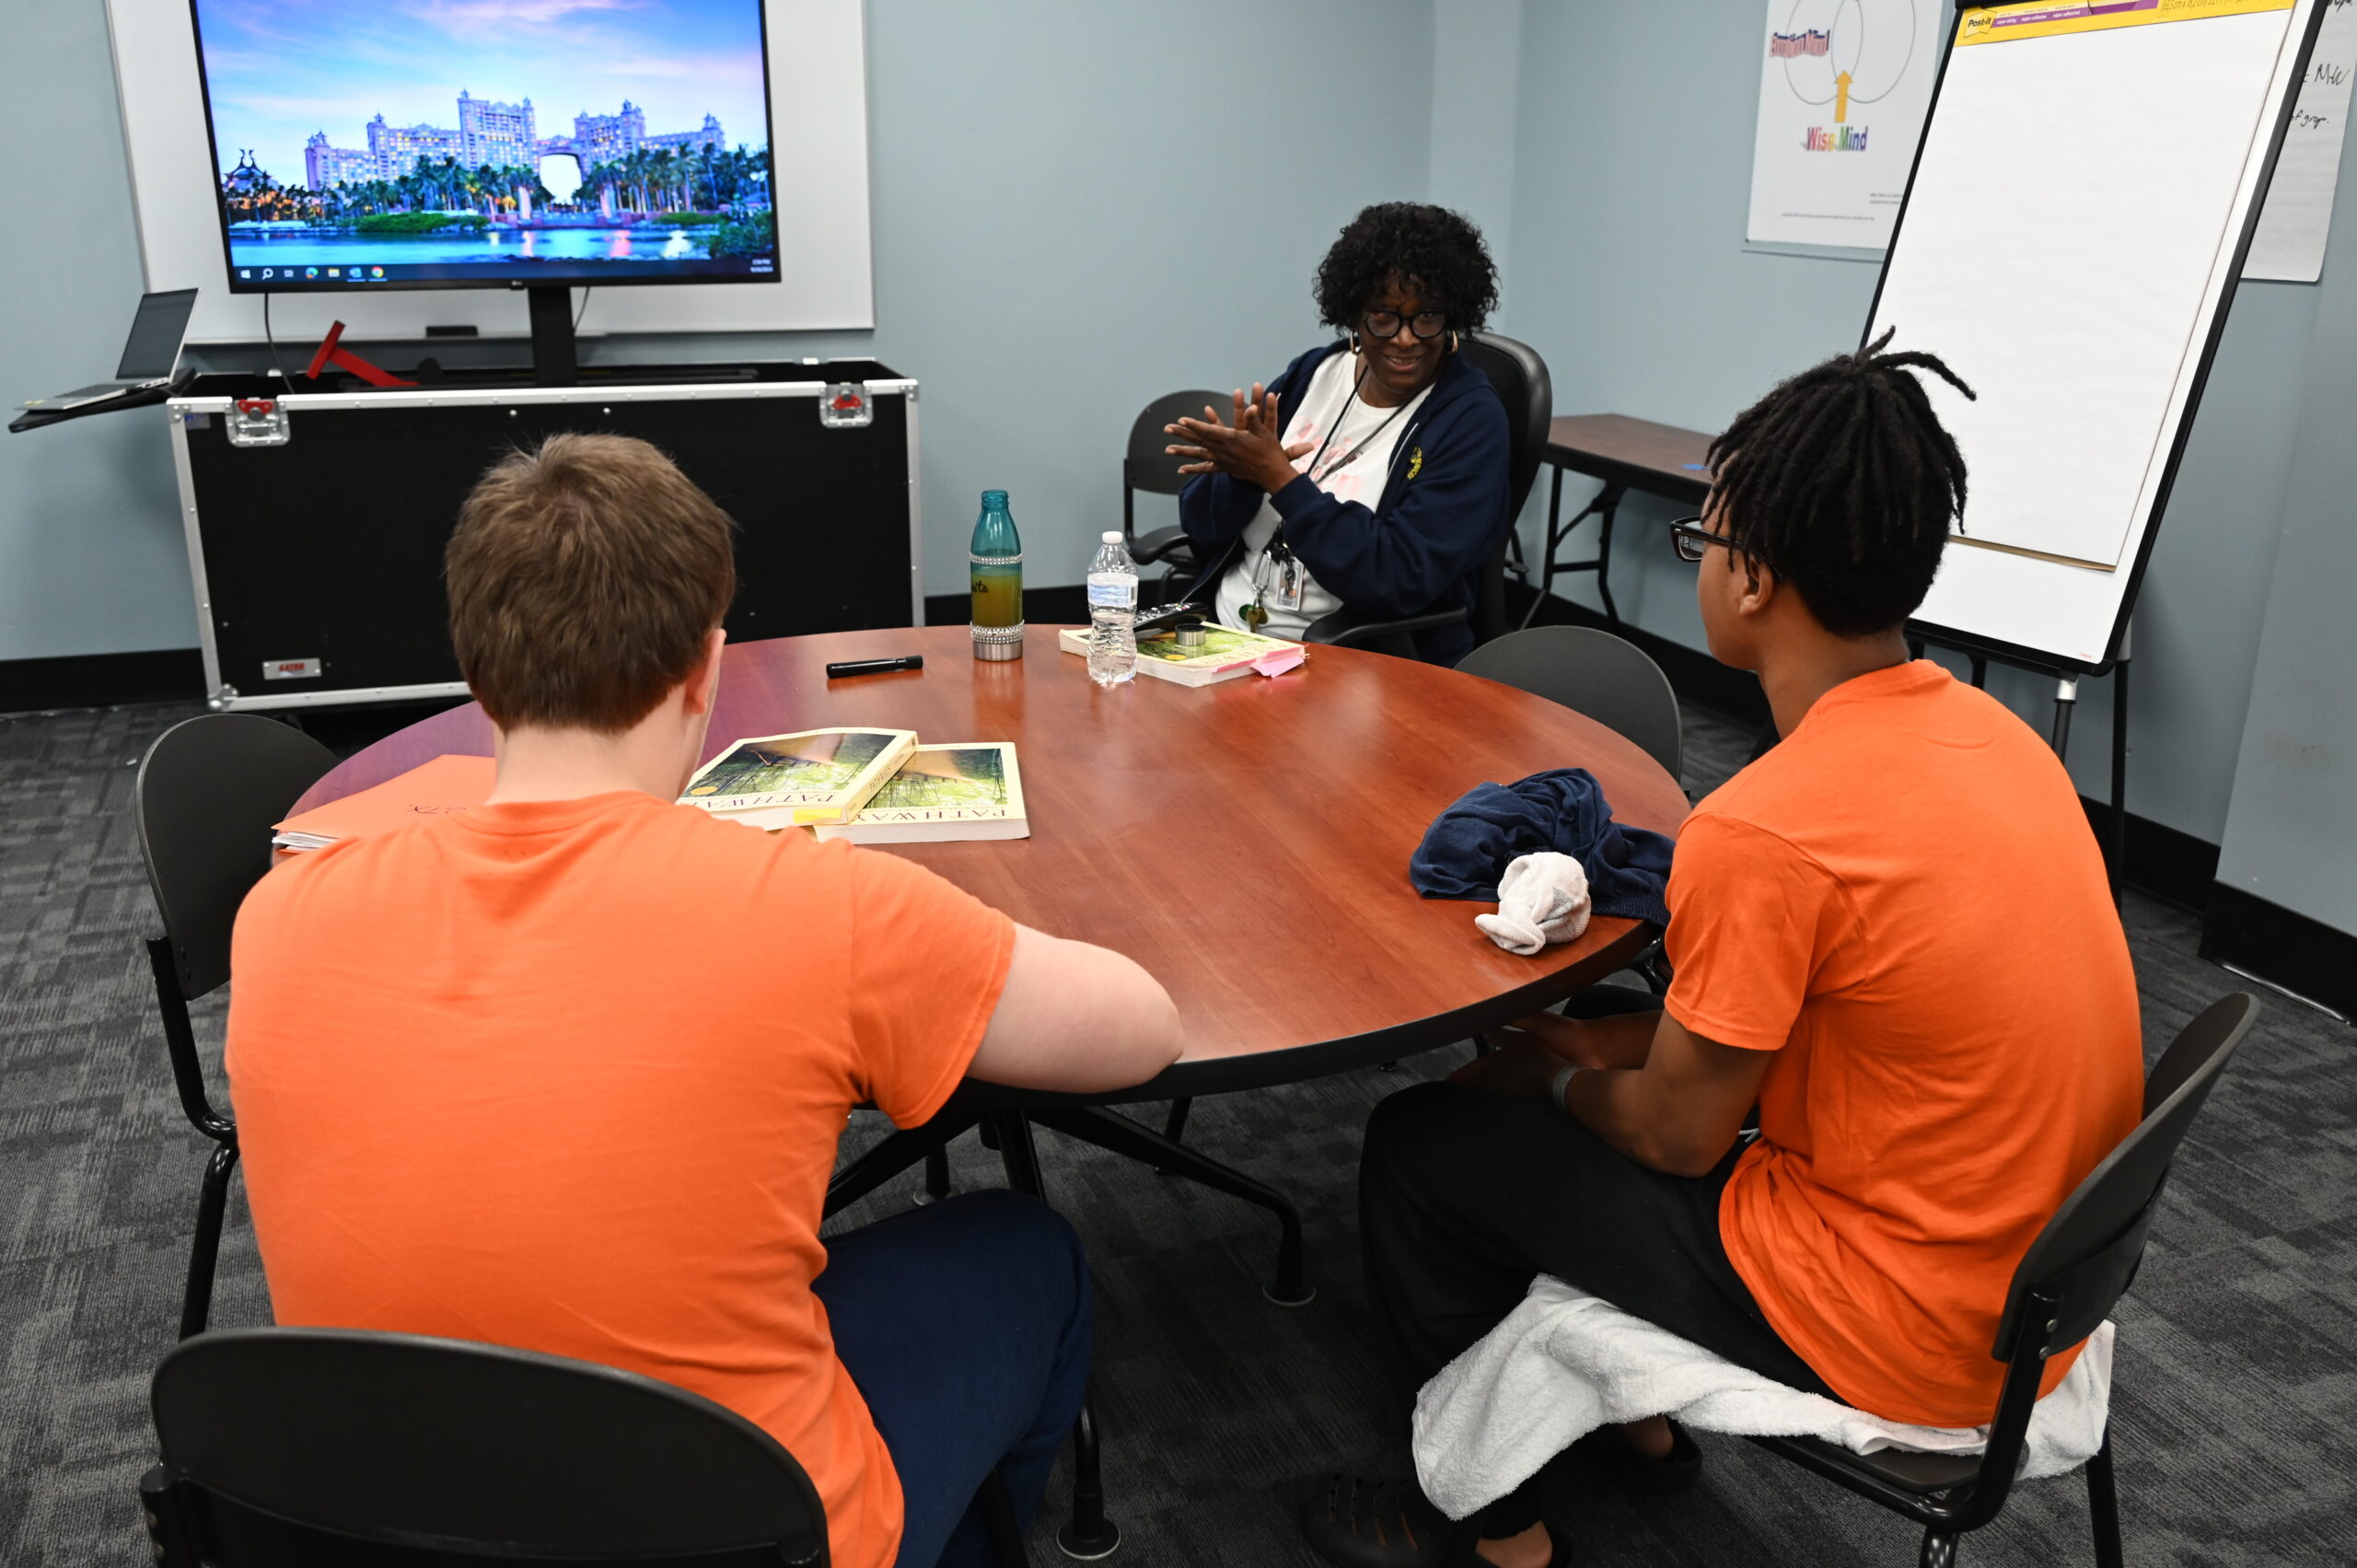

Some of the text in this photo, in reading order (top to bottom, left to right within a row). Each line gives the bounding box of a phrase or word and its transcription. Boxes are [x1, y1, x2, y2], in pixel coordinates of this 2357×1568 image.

[1968, 17, 1991, 28] Post-it
[1806, 126, 1868, 151] Wise Mind
[681, 794, 834, 808] PATHWA
[854, 809, 1005, 821] PATHWAY
